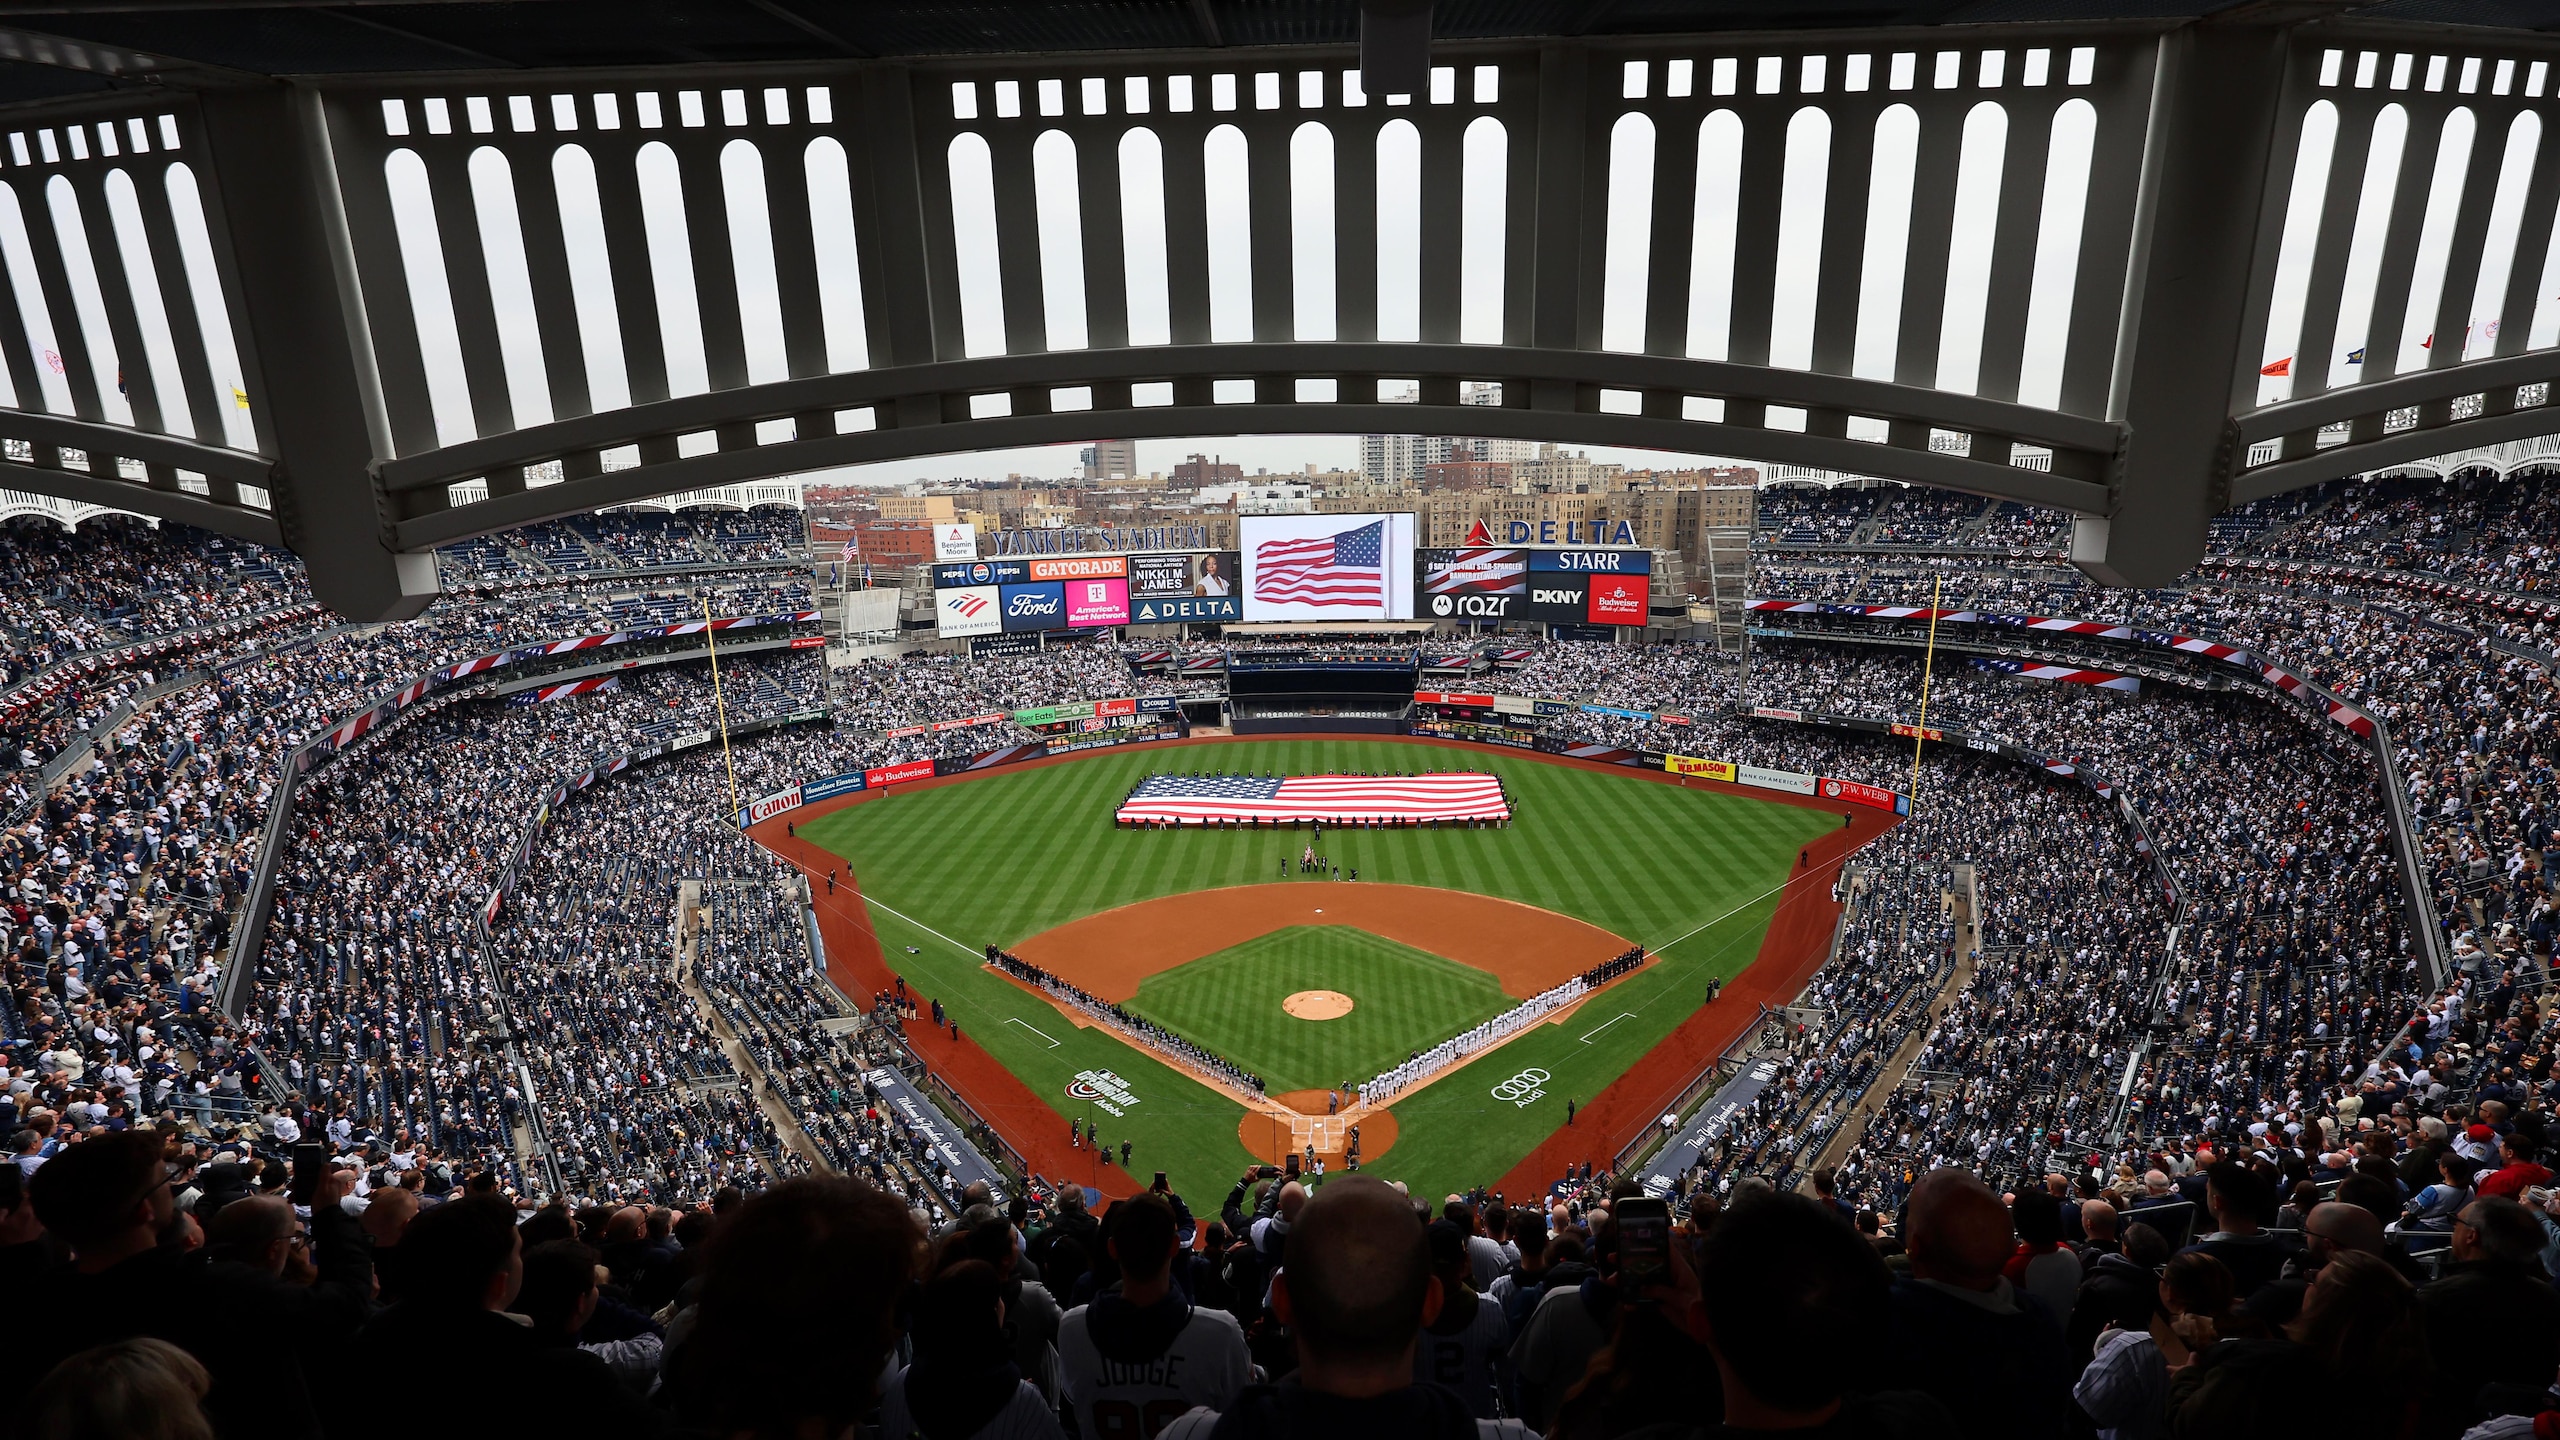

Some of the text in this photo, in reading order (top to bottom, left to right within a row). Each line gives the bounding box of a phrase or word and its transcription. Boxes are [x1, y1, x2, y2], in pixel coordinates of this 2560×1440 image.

[1509, 520, 1637, 545] DELTA
[941, 541, 972, 549] Benjamin
[990, 525, 1208, 556] YANKEE STADIUM
[1035, 559, 1123, 577] GATORADE
[1476, 563, 1523, 571] STAR-SPANGLED
[1559, 552, 1620, 570] STARR
[942, 570, 966, 579] PEPSI
[997, 567, 1020, 575] PEPSI
[1136, 569, 1187, 580] NIKKI M.
[1140, 579, 1183, 590] JAMES
[1533, 589, 1583, 604] DKNY
[1598, 597, 1639, 607] Budweiser
[1008, 593, 1059, 617] Ford
[1075, 605, 1120, 614] America's
[1163, 601, 1235, 617] DELTA
[1457, 596, 1510, 616] razr
[1069, 611, 1127, 621] Best Network
[969, 621, 999, 629] AMERICA
[788, 712, 823, 722] Poland Spring
[1016, 712, 1054, 723] Uber Eats
[1111, 713, 1162, 727] A SUB ABOVE
[1510, 715, 1537, 725] StubHub
[1772, 710, 1799, 719] Authority
[680, 734, 704, 747] ORIS
[1070, 743, 1091, 751] StubHub
[1092, 740, 1115, 748] StubHub
[1967, 738, 2000, 754] 1:25 PM
[638, 746, 663, 761] 1:25 PM
[1643, 756, 1665, 765] LEGORA
[805, 781, 836, 796] Montefiore
[836, 776, 861, 788] Einstein
[1768, 776, 1798, 786] AMERICA
[1842, 783, 1860, 795] F.W.
[1862, 787, 1889, 802] WEBB
[751, 791, 801, 820] Canon
[1514, 1088, 1547, 1109] Audi
[1094, 1099, 1125, 1117] Adobe
[1683, 1101, 1739, 1149] New York Yankees
[1096, 1354, 1185, 1389] JUDGE
